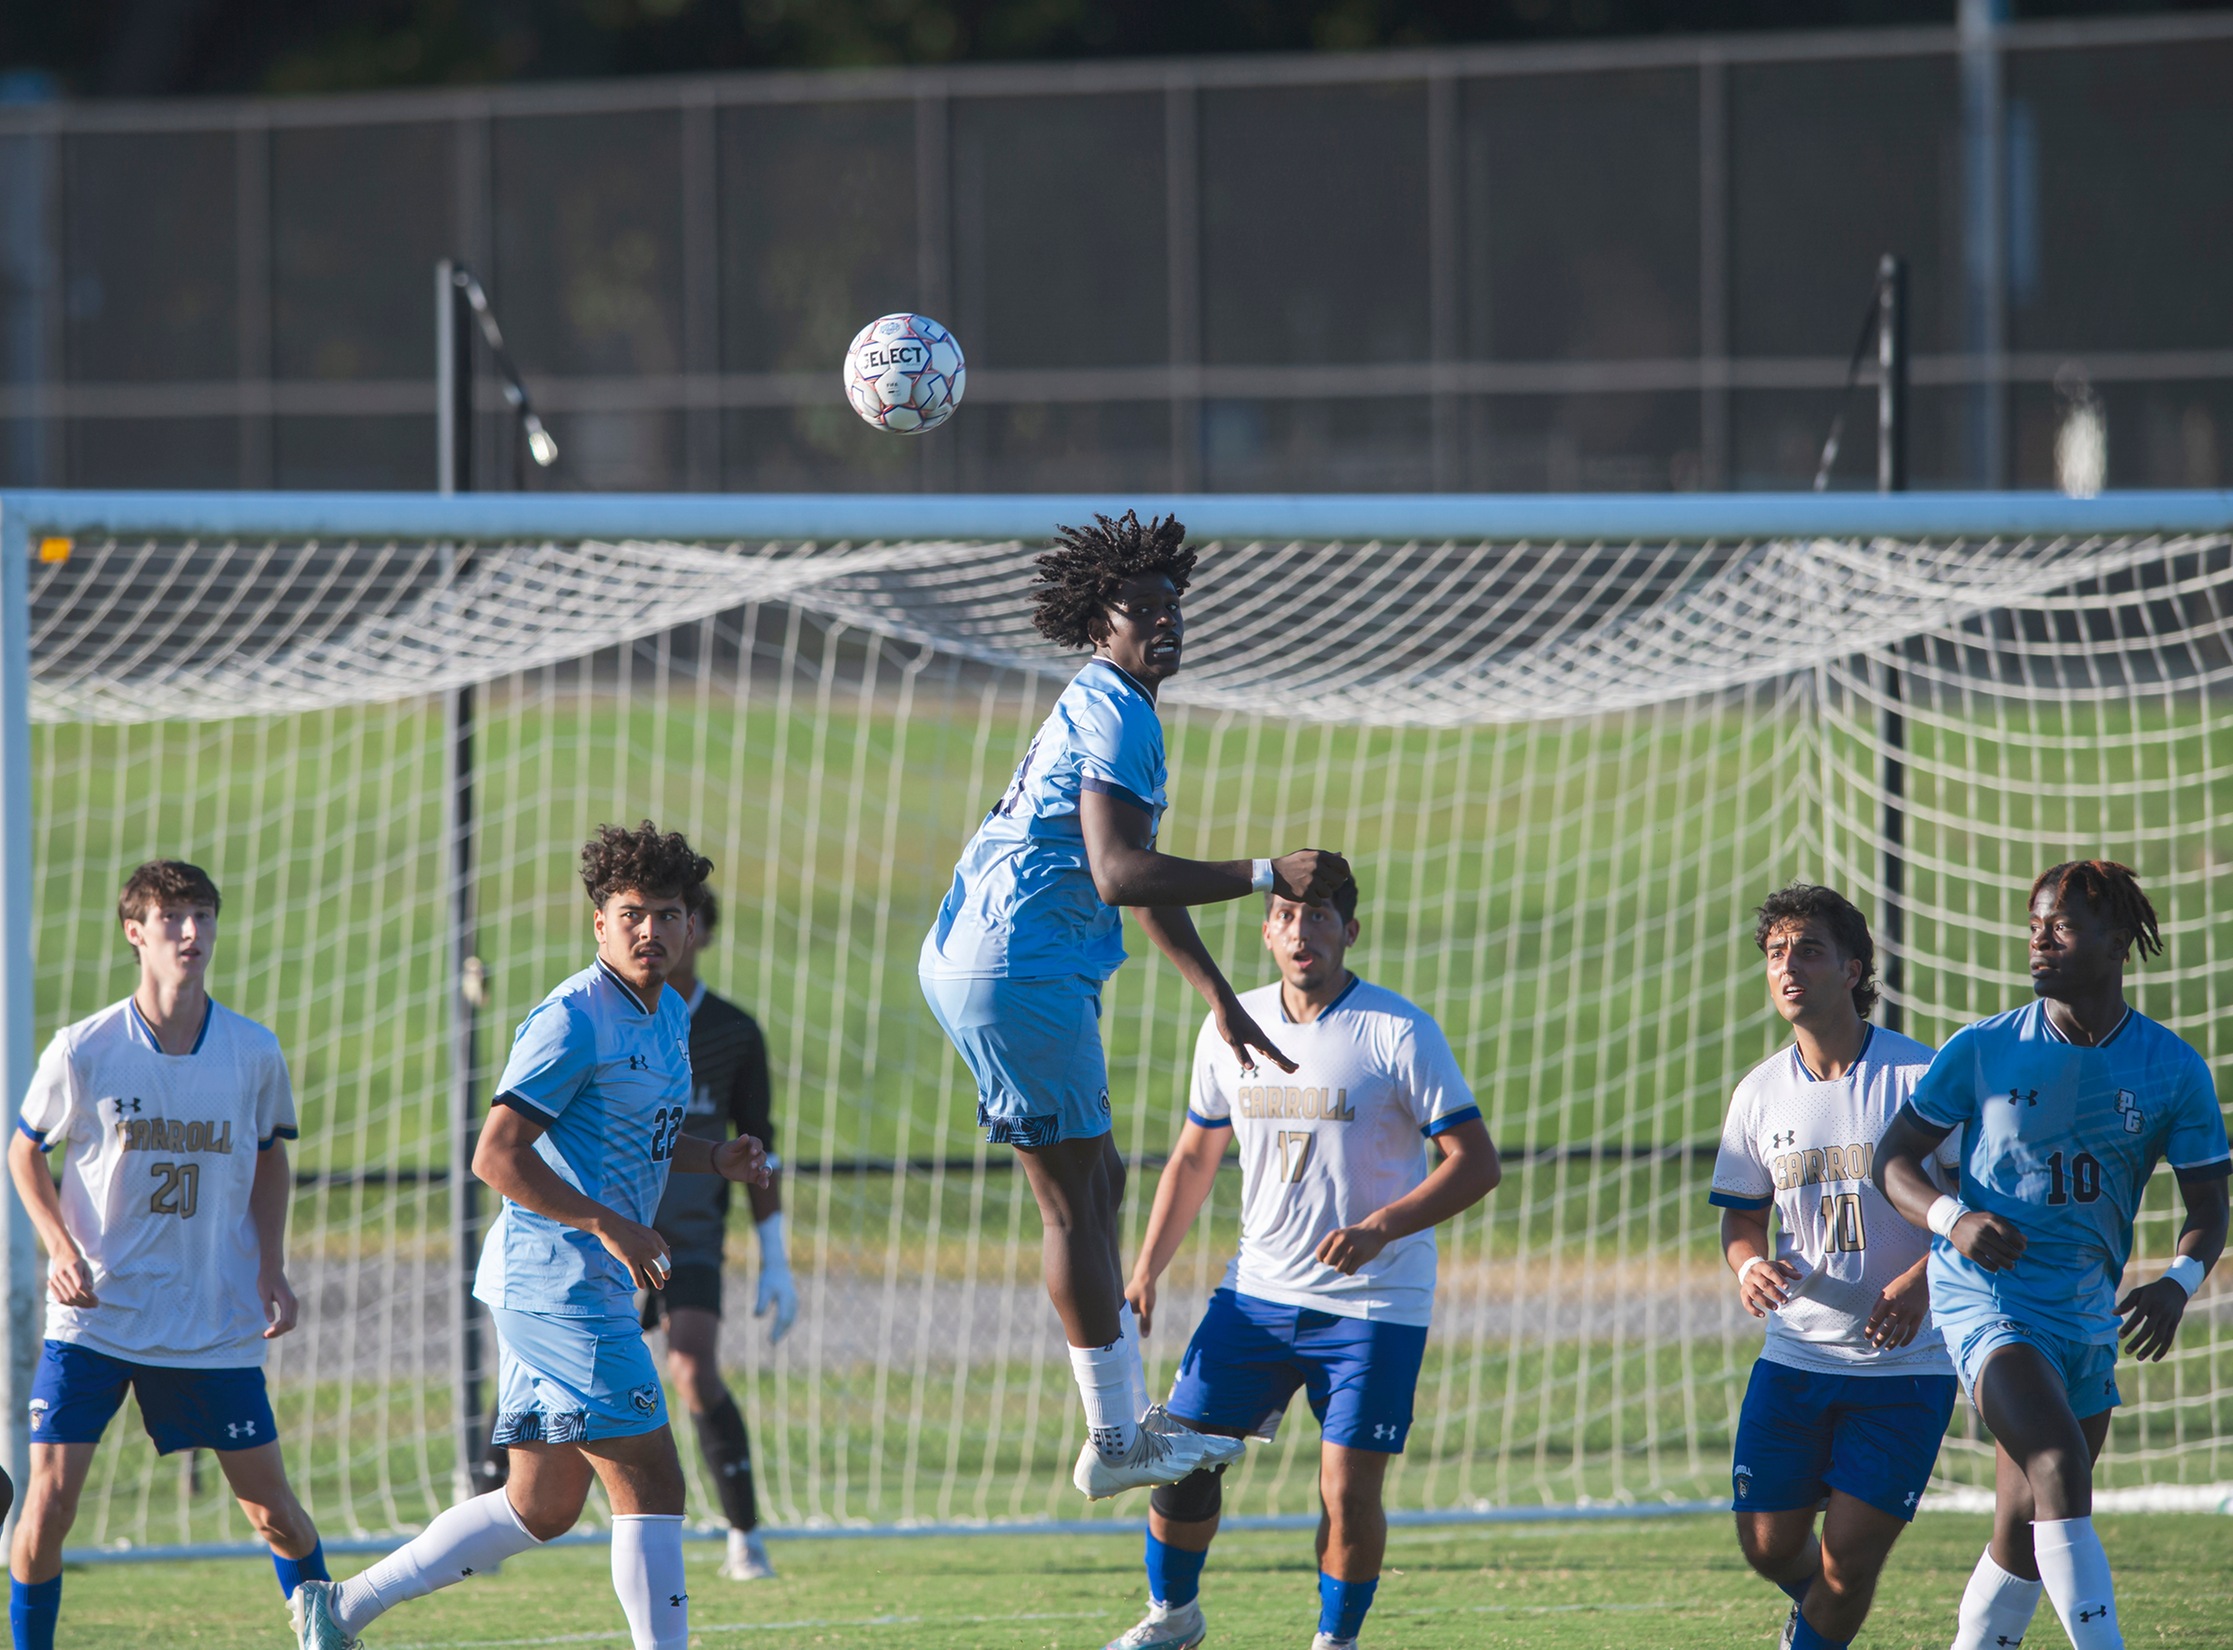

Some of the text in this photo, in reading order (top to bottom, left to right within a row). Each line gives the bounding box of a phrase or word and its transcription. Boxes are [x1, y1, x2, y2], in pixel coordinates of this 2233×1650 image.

[1238, 1086, 1355, 1122] CARROLL
[115, 1117, 234, 1154] CARROLL
[651, 1105, 684, 1163] 22
[1277, 1131, 1312, 1183] 17
[151, 1162, 199, 1219] 20
[2046, 1151, 2101, 1206] 10
[1821, 1193, 1867, 1253] 10
